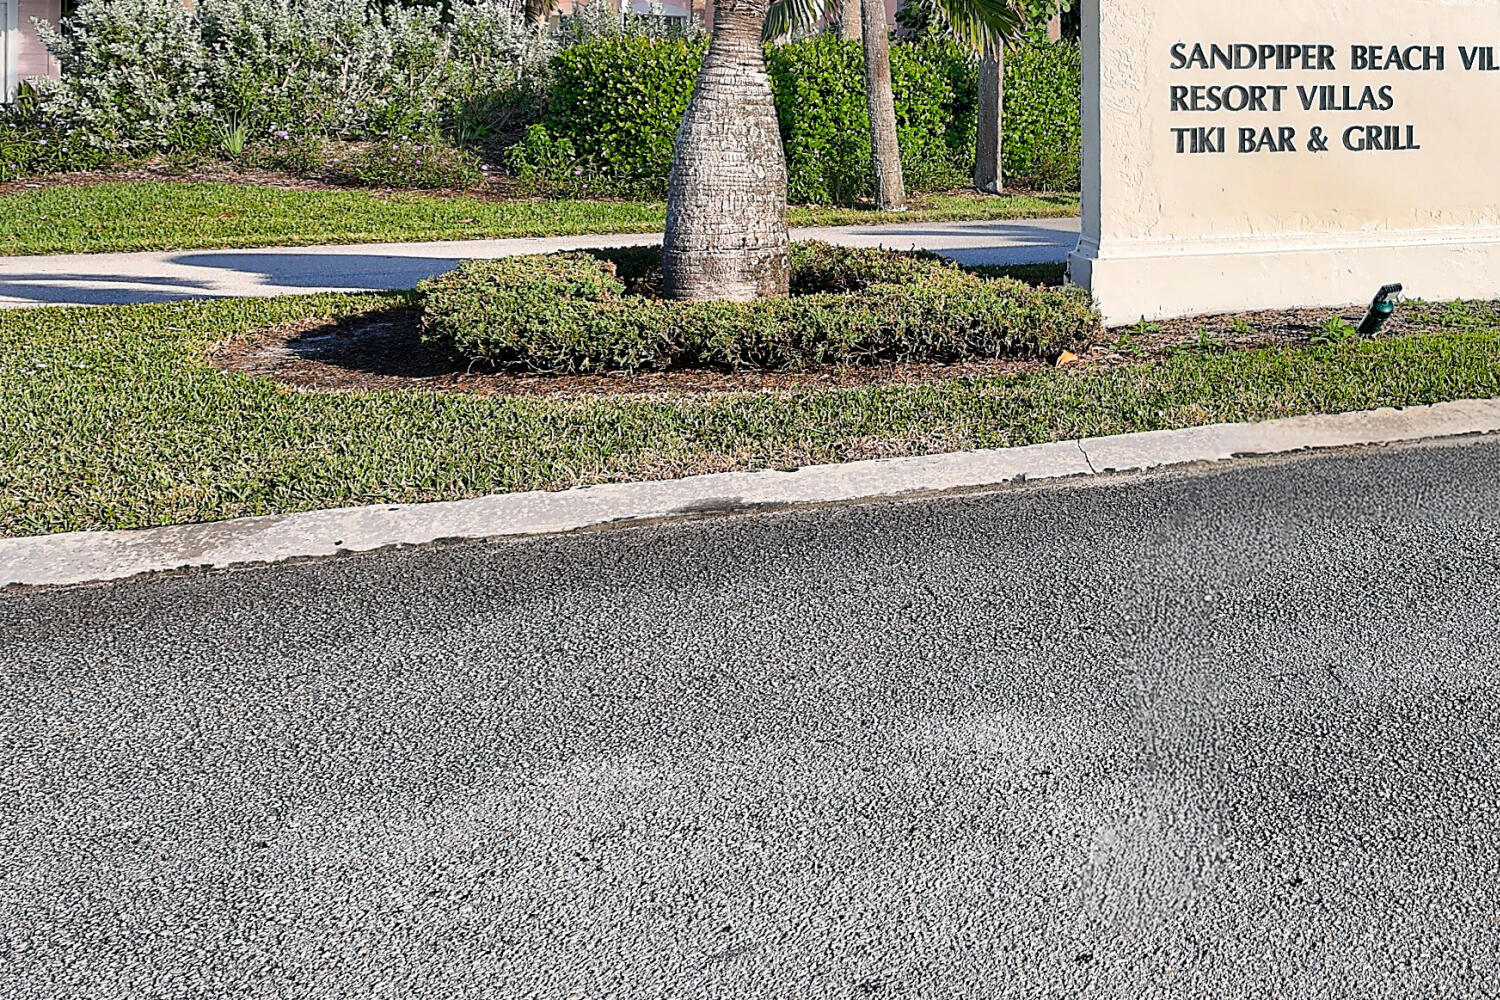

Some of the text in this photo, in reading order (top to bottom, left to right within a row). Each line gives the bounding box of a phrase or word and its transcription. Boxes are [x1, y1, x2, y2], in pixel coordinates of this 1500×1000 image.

[1170, 43, 1336, 71] SANDPIPER
[1350, 44, 1445, 71] BEACH
[1169, 85, 1394, 112] RESORT VILLAS
[1170, 124, 1421, 154] TIKI BAR & GRILL
